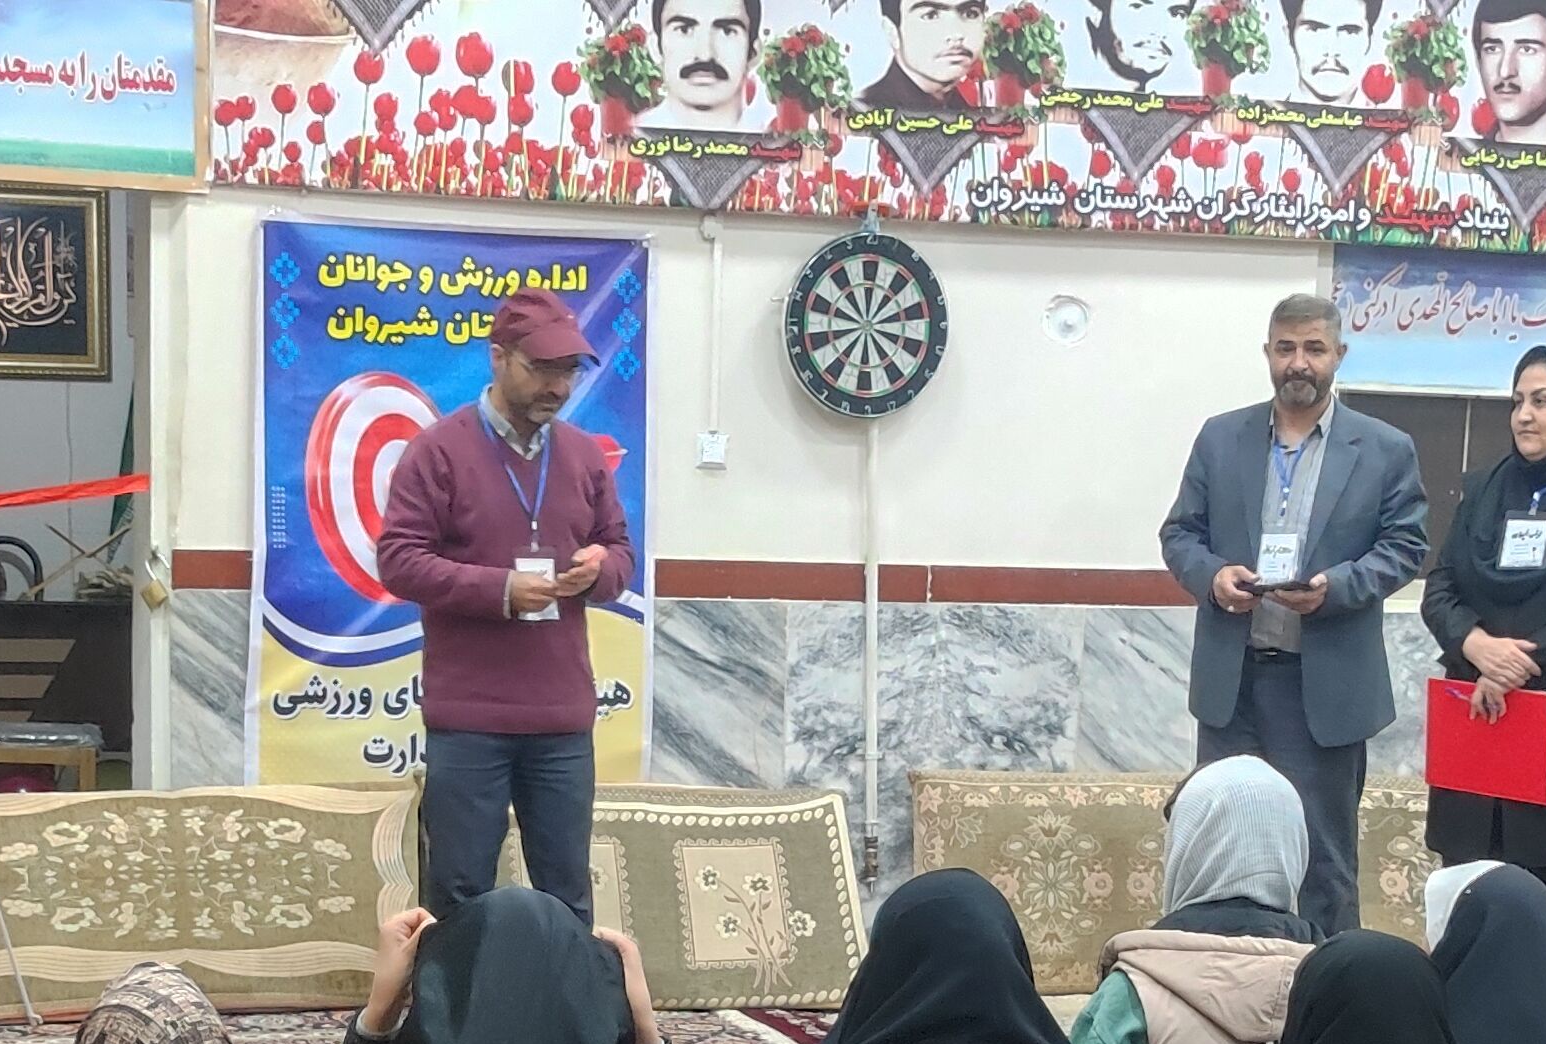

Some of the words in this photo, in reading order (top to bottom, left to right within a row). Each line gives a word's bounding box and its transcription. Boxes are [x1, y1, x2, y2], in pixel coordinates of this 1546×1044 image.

[0, 53, 54, 94] مسجد
[58, 58, 76, 97] به
[79, 50, 98, 101] را
[100, 53, 176, 101] مقدمتان
[1093, 92, 1134, 107] محمد
[1134, 93, 1165, 113] علی
[848, 108, 895, 130] آبادی
[896, 114, 941, 133] حسین
[942, 114, 975, 135] علی
[1237, 104, 1305, 125] محمدزاده
[1306, 108, 1363, 130] عباسعلی
[630, 135, 670, 156] نوری
[673, 135, 702, 158] رضا
[704, 140, 748, 156] محمد
[1461, 148, 1505, 169] رضایی
[1506, 150, 1534, 170] علی
[971, 179, 1066, 212] شیروان
[1073, 183, 1193, 219] شهرستان
[1196, 187, 1303, 224] ایثارگران
[1305, 199, 1353, 230] امور
[1355, 208, 1372, 232] و
[1375, 203, 1456, 233] شهید
[1457, 205, 1511, 239] بنیاد
[318, 254, 412, 292] جوانان
[419, 266, 434, 294] و
[440, 256, 520, 297] ورزش
[327, 306, 439, 343] شیروان
[273, 675, 373, 717] ورزشی
